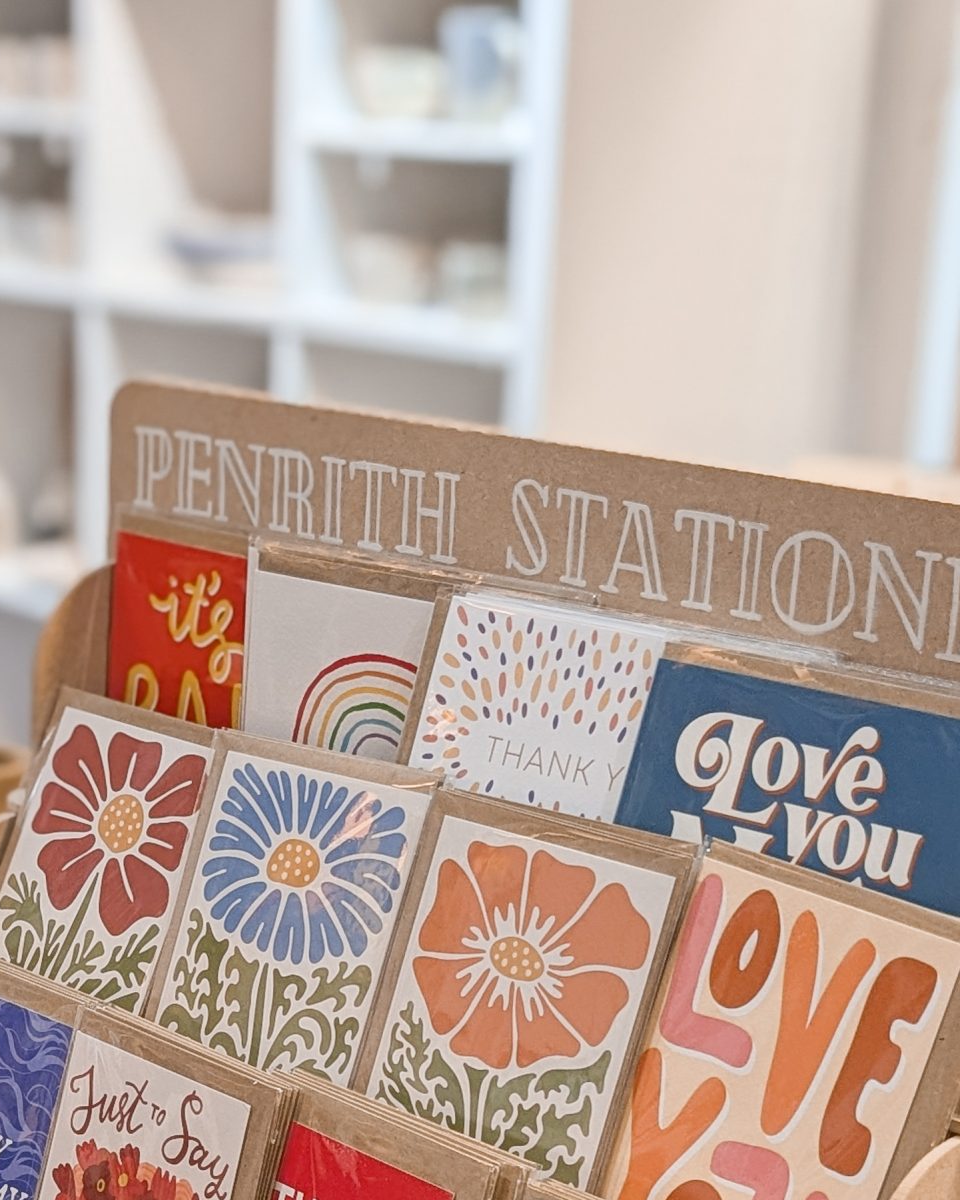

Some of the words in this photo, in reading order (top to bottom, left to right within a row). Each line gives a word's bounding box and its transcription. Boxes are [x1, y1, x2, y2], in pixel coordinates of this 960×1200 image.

[133, 425, 461, 565] PENRITH
[488, 735, 595, 786] THANK
[675, 711, 887, 827] Love
[783, 802, 925, 890] you
[659, 873, 939, 1178] LOVE
[70, 1065, 148, 1135] Just
[161, 1090, 229, 1200] Say
